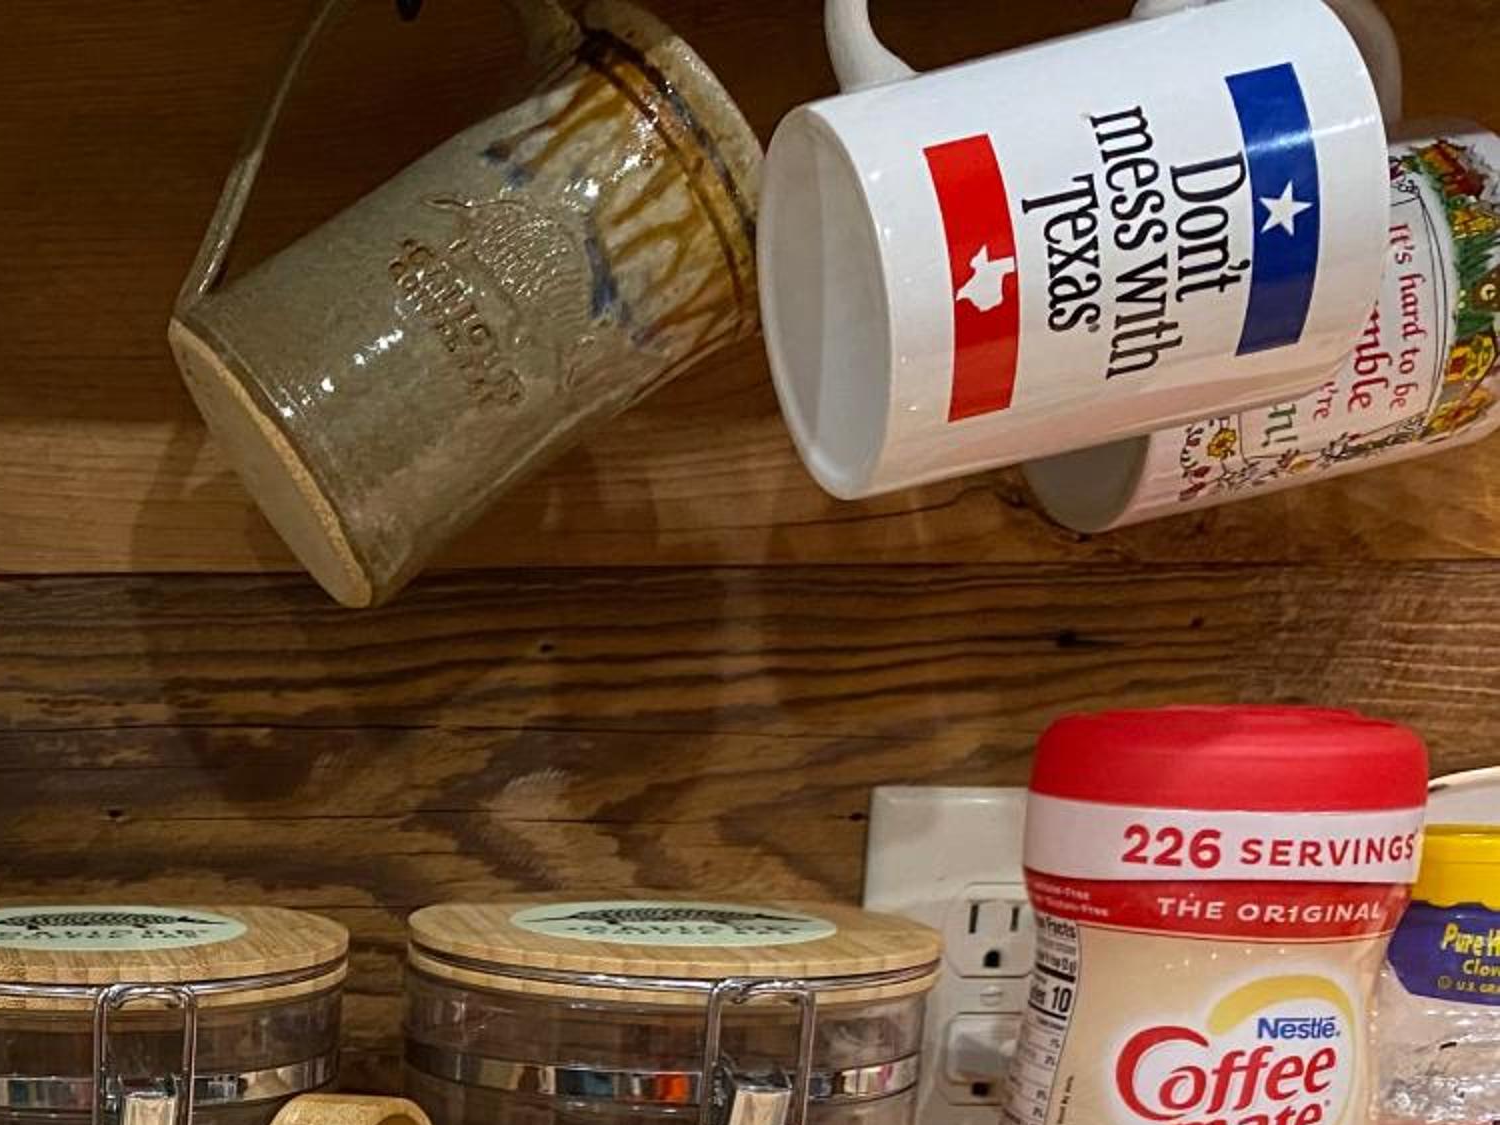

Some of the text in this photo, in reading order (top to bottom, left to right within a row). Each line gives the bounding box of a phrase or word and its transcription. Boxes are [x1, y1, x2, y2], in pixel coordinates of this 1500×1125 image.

[1089, 105, 1183, 380] mess with
[1169, 152, 1251, 303] Don't
[1388, 223, 1427, 409] It's hard to be
[1121, 824, 1222, 870] 226
[1157, 896, 1382, 924] THE ORIGINAL
[1440, 922, 1484, 957] Pure
[1050, 985, 1073, 1013] 10
[1257, 1017, 1336, 1039] Nestlé
[1115, 1024, 1336, 1121] Coffee
